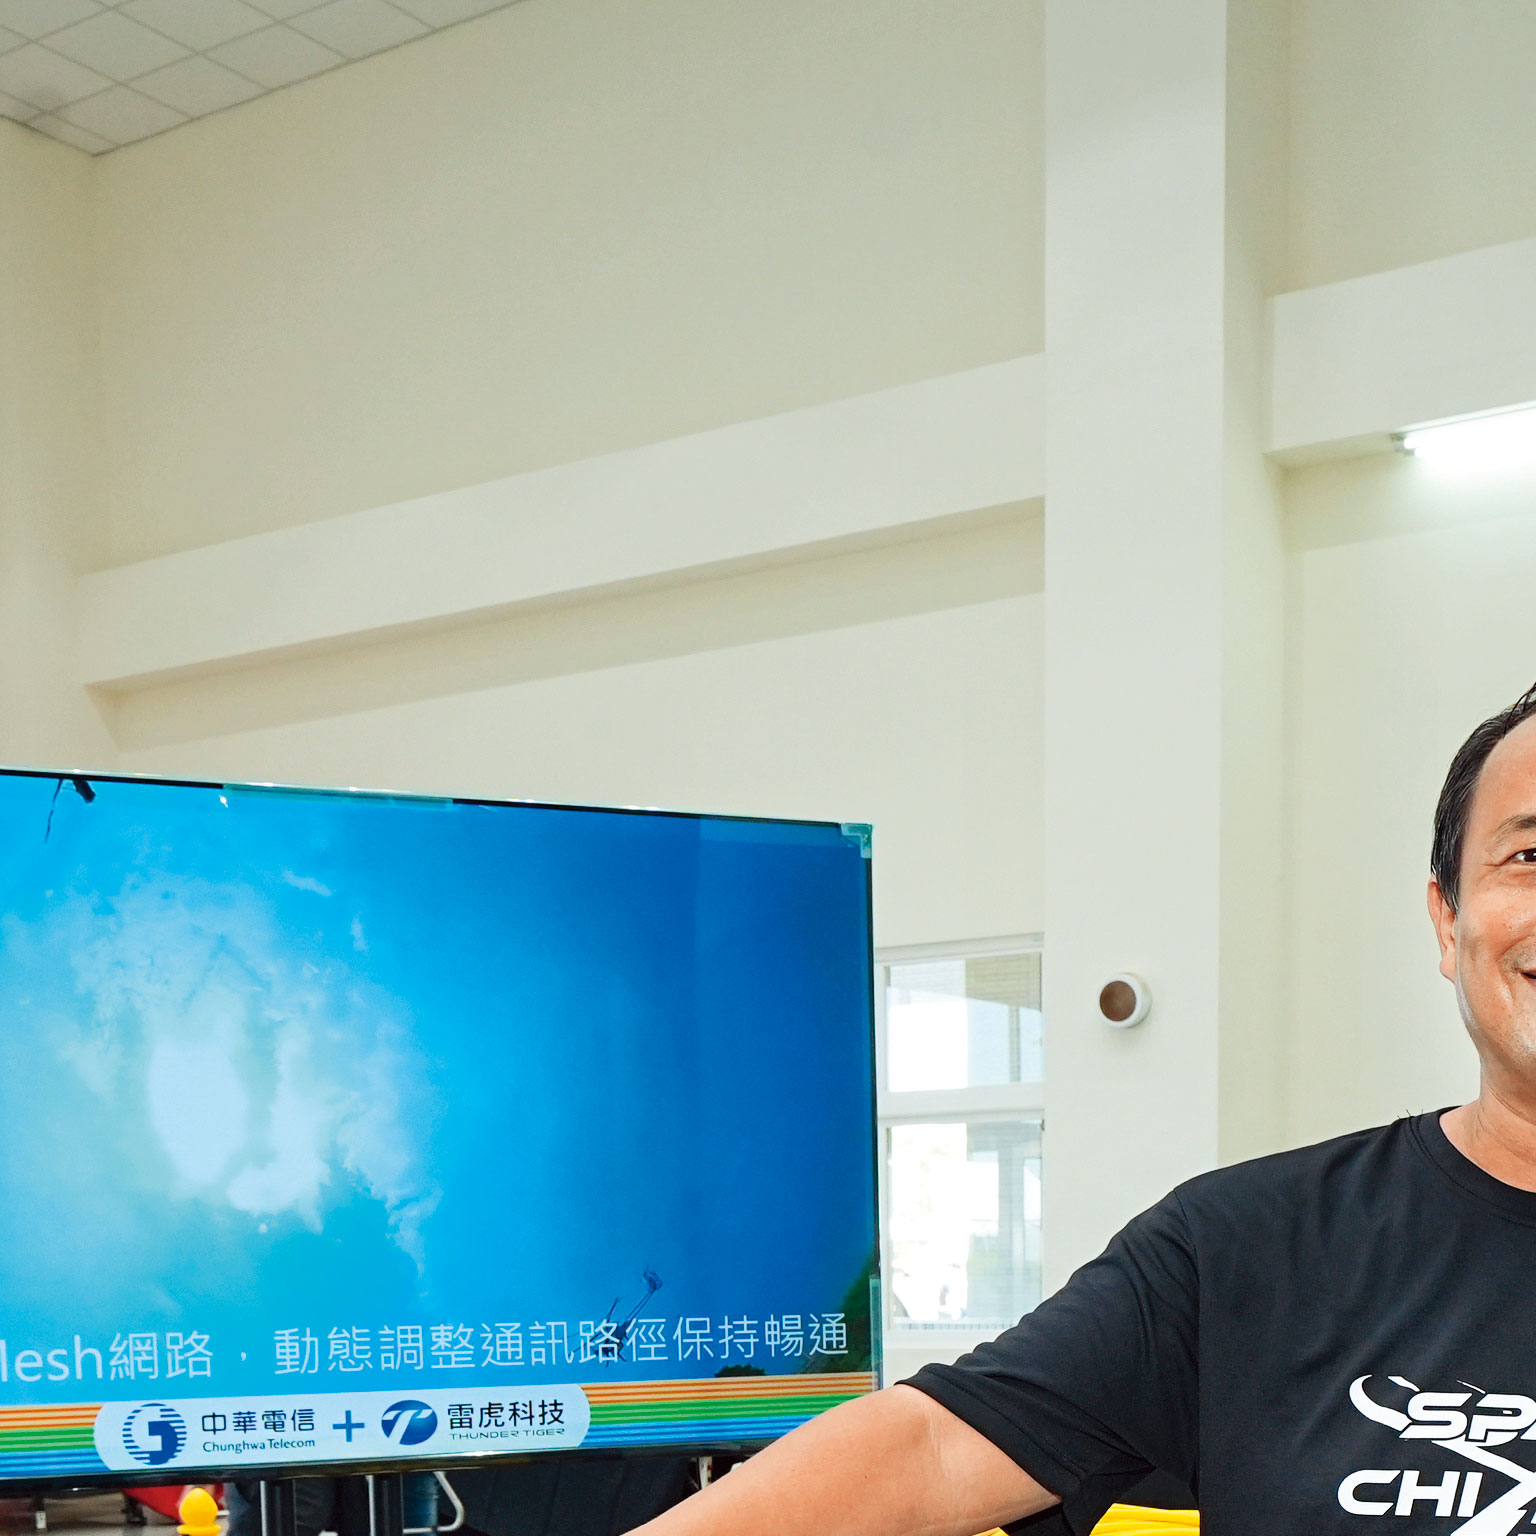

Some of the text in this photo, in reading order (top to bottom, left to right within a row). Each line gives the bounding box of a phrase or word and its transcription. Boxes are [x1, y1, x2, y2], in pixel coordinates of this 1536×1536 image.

[201, 1407, 316, 1435] 中華電信
[446, 1400, 565, 1430] 雷虎科技
[202, 1437, 316, 1455] Chunghwa Telecom
[449, 1428, 565, 1441] THUNDER TIGER
